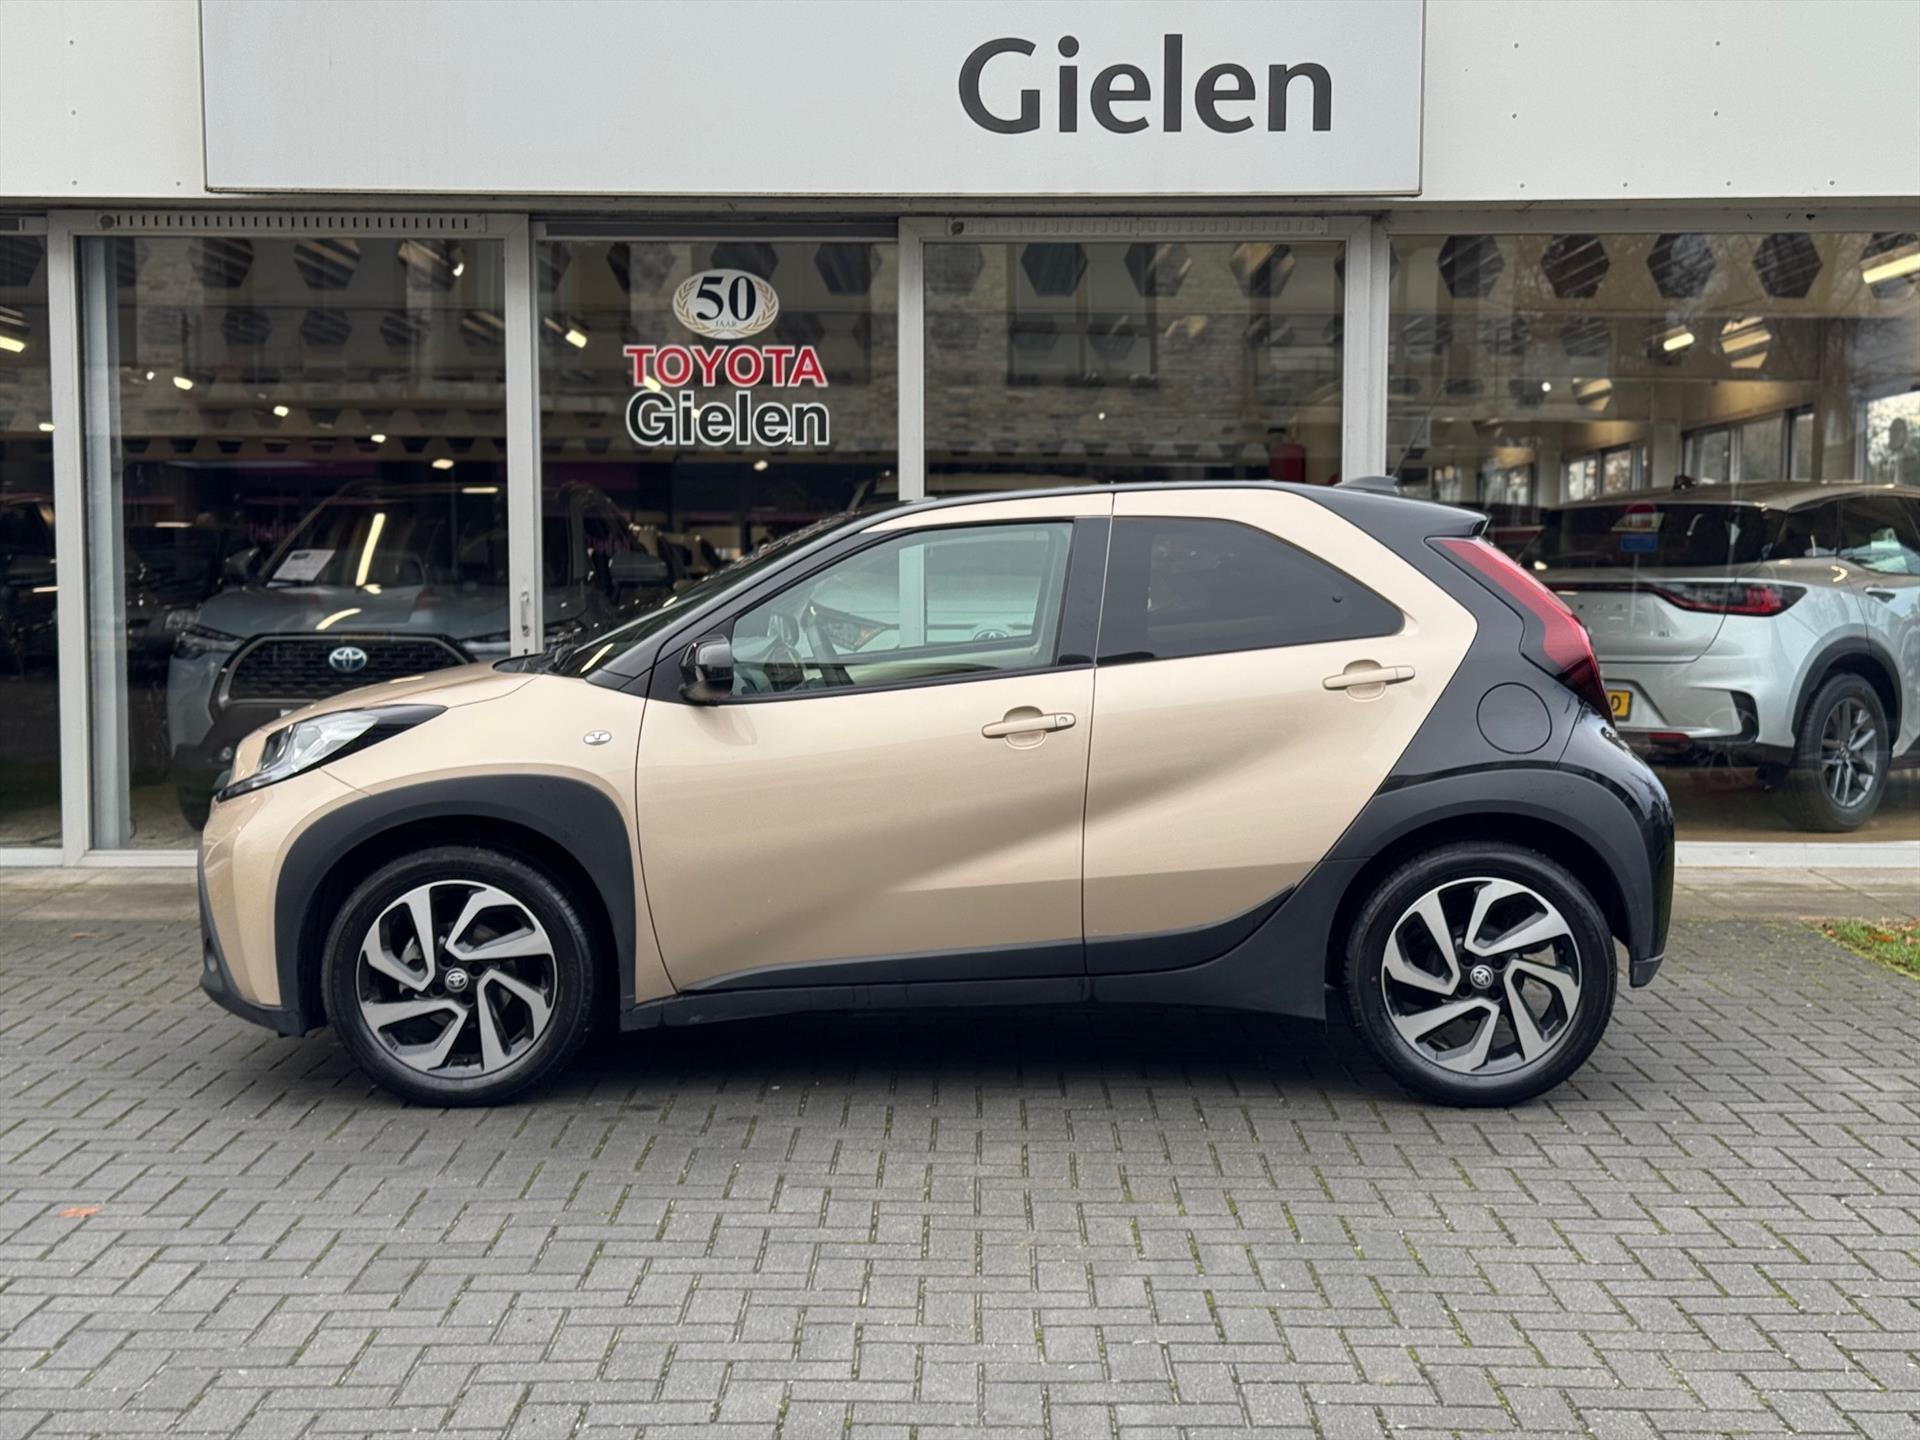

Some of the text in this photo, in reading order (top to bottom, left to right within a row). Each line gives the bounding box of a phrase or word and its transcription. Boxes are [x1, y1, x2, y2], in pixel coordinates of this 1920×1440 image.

[958, 33, 1332, 135] Gielen
[695, 275, 757, 321] 50
[624, 345, 828, 387] TOYOTA
[626, 389, 830, 446] Gielen
